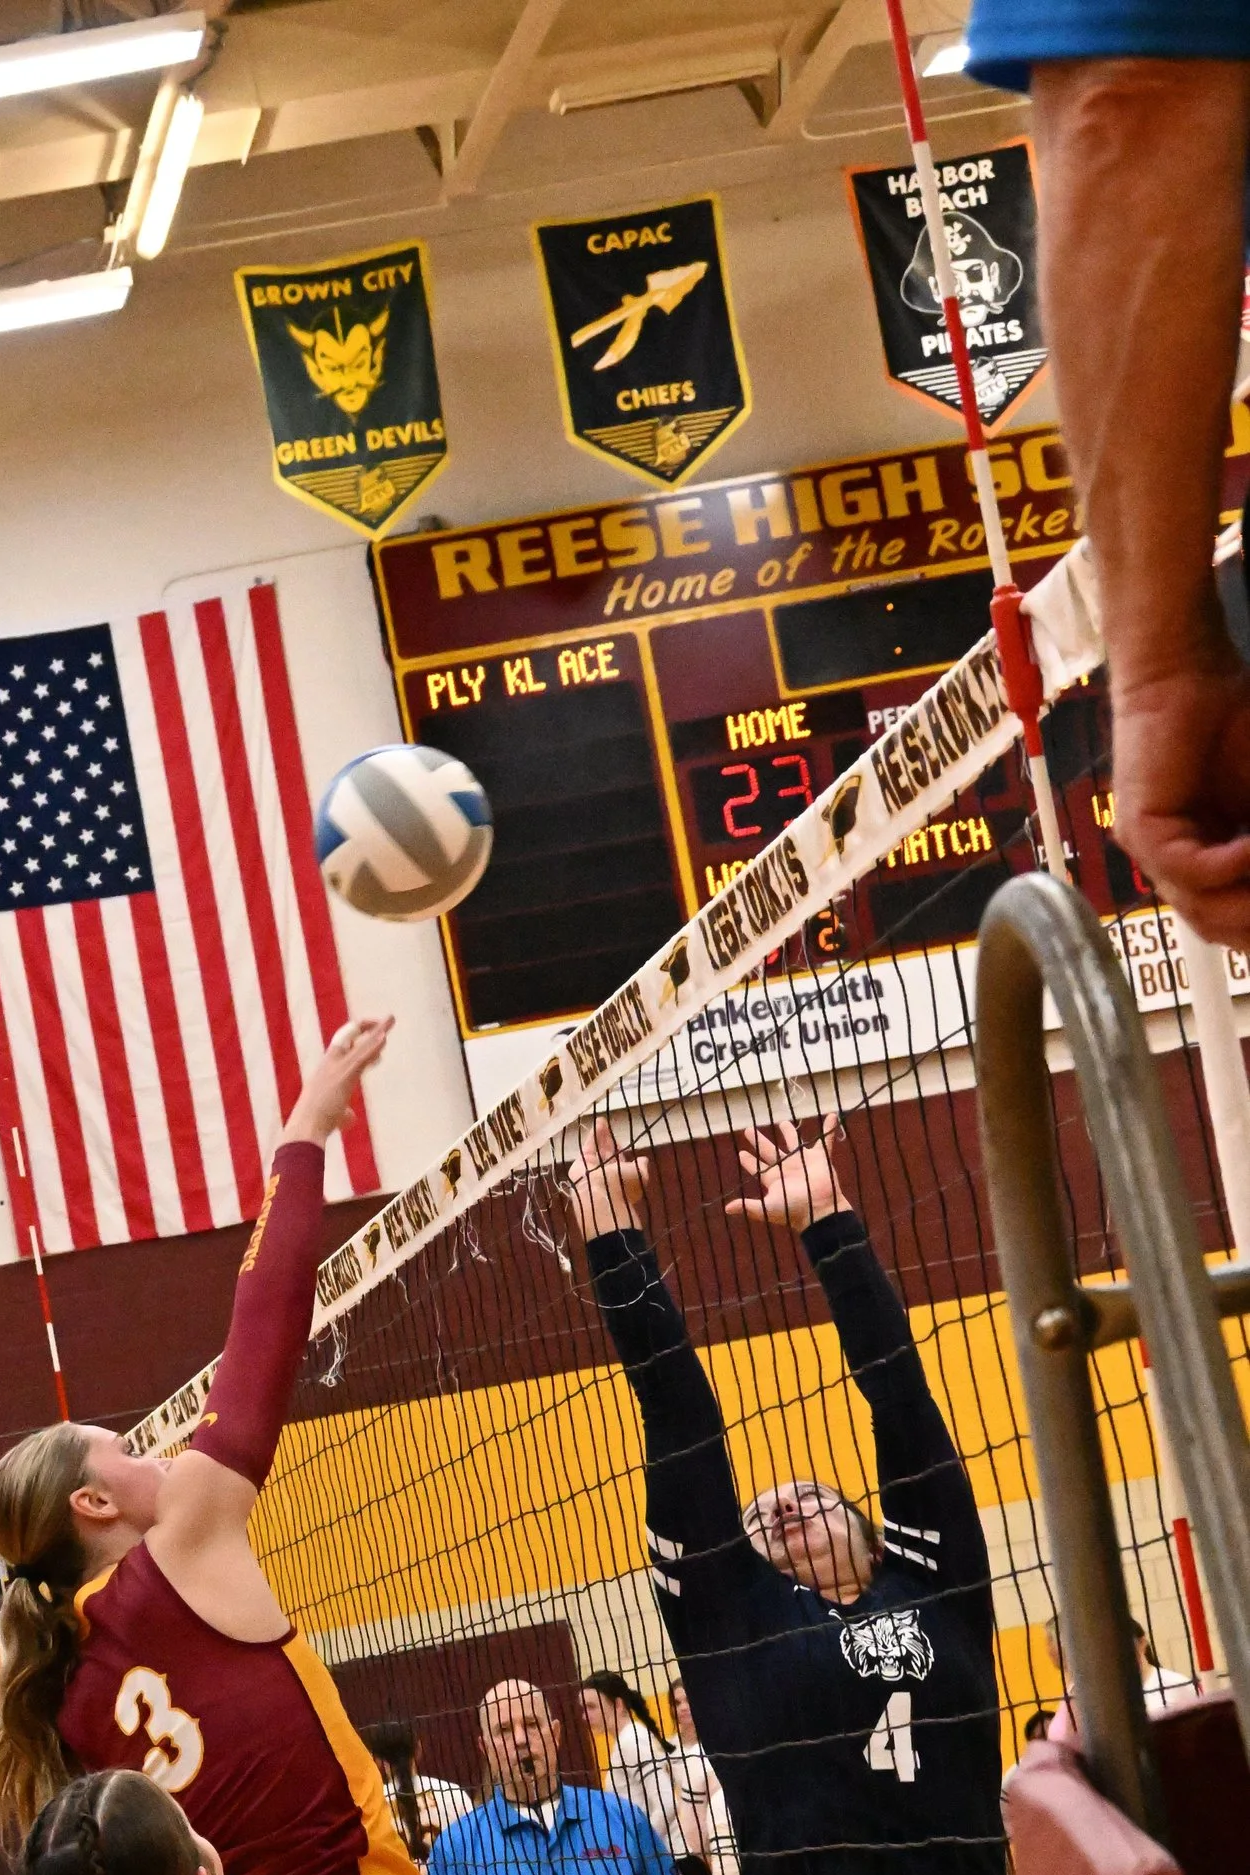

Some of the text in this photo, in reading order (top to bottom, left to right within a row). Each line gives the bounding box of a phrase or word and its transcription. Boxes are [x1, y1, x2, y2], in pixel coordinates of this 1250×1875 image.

[905, 185, 989, 218] BACH
[587, 222, 673, 254] CAPAC
[252, 262, 413, 307] BROWN CITY
[921, 320, 1024, 358] PIATES
[616, 380, 696, 412] CHIEFS
[277, 418, 444, 465] GREEN DEVILS
[431, 496, 712, 600] REESE
[725, 456, 945, 546] HIGH
[603, 567, 737, 616] Home
[757, 542, 814, 588] of
[831, 530, 906, 574] the
[427, 642, 620, 709] PLY KL ACE
[726, 702, 812, 751] HOME
[721, 754, 814, 838] 23
[817, 910, 840, 952] 2
[1108, 917, 1178, 962] EESE
[689, 973, 884, 1033] ankenmuth
[694, 1012, 890, 1065] Credit Union
[114, 1666, 205, 1793] 3
[862, 1691, 921, 1783] 4
